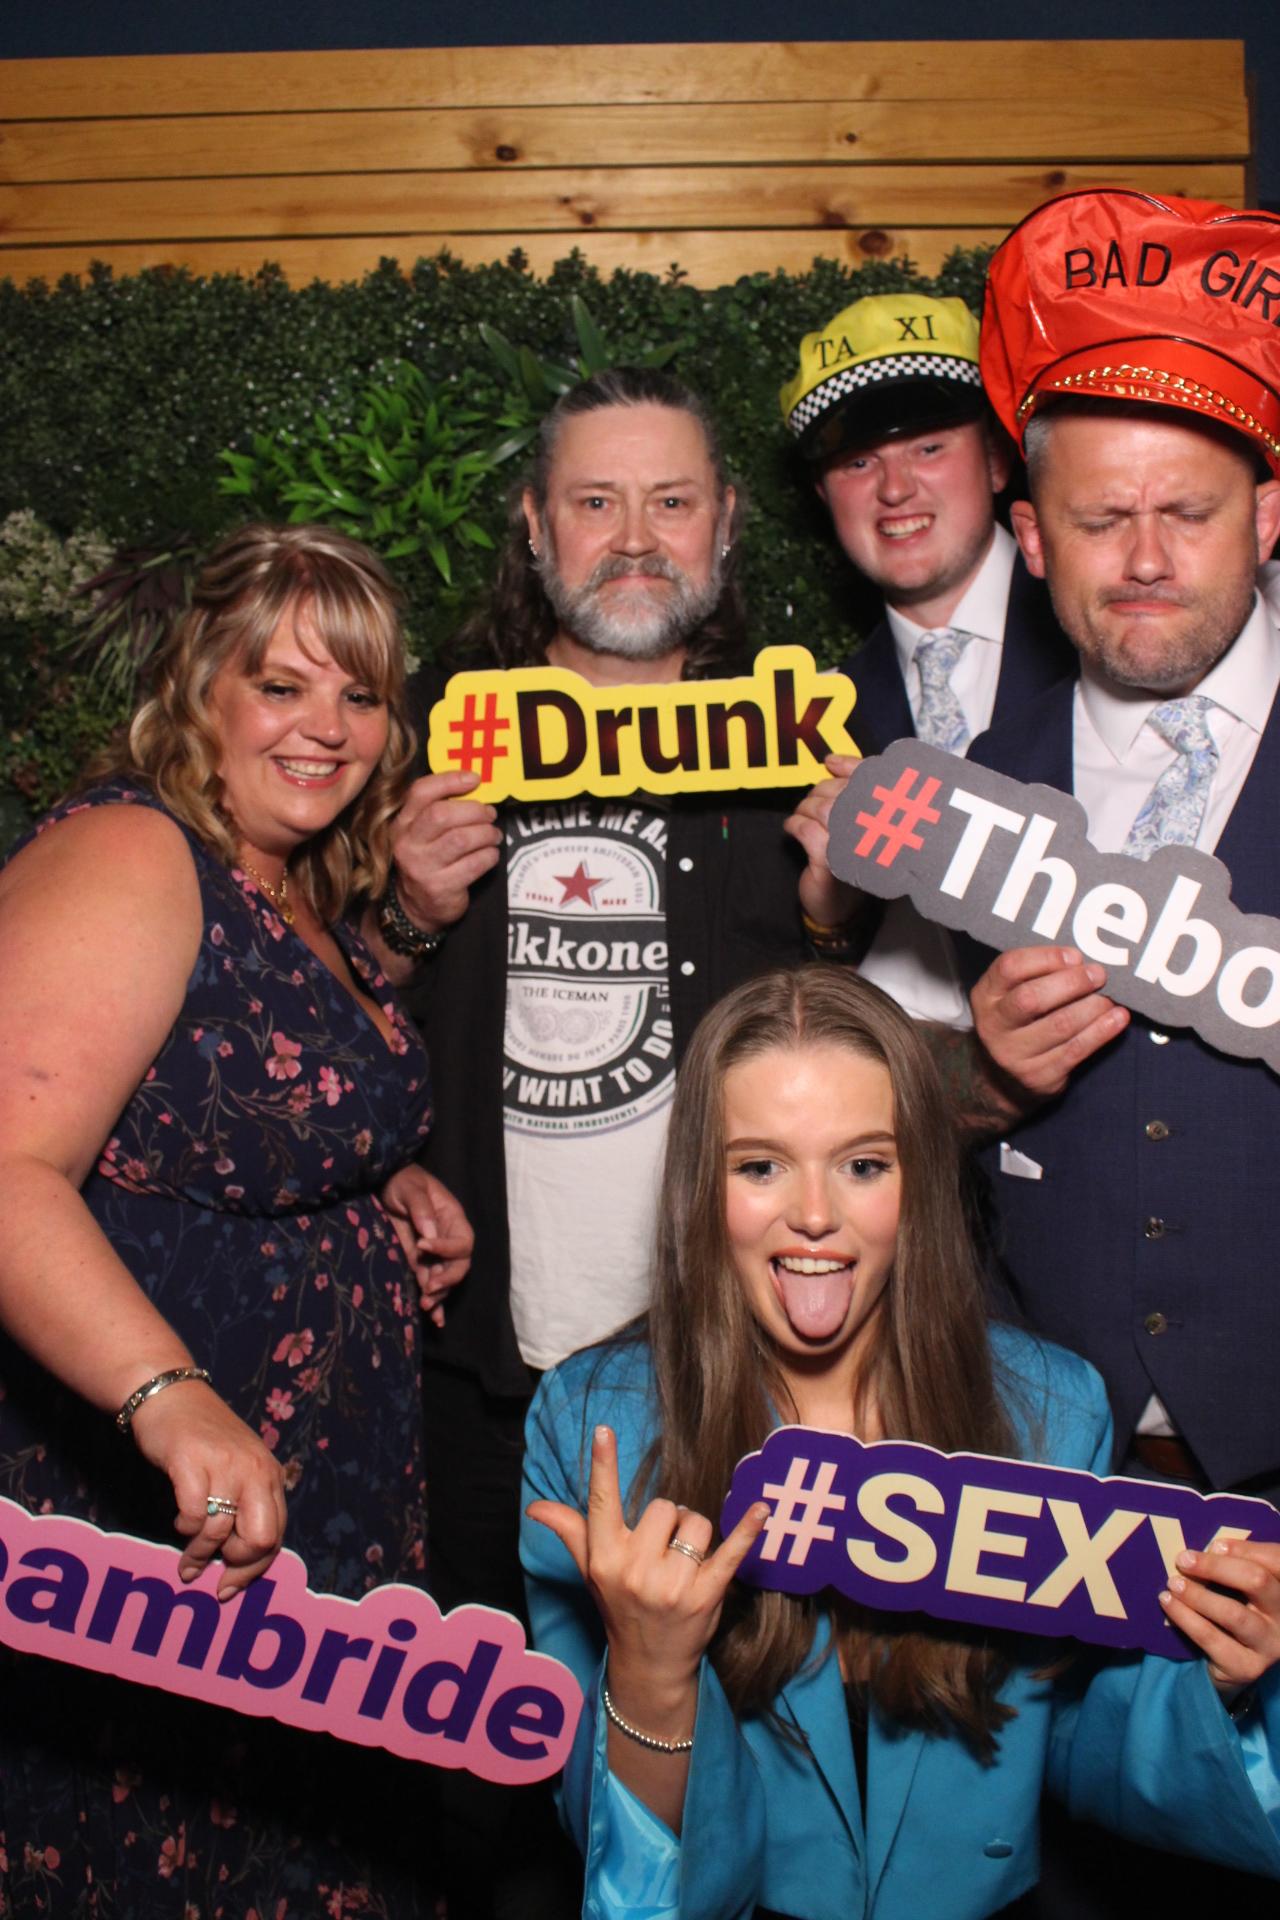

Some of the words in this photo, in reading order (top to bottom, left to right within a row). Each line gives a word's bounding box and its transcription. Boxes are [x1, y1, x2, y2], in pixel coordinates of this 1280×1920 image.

[1064, 239, 1172, 290] BAD
[447, 668, 835, 783] #Drunk
[516, 803, 592, 838] LEAVE
[598, 805, 643, 835] ME
[522, 985, 548, 998] THE
[552, 987, 610, 1002] ICEMAN
[517, 1074, 603, 1107] WHAT
[608, 1057, 653, 1094] TO
[641, 1019, 674, 1060] DO
[526, 1117, 569, 1131] NATURAL
[573, 1106, 638, 1129] INGREDIENTS
[0, 1538, 566, 1761] ambride
